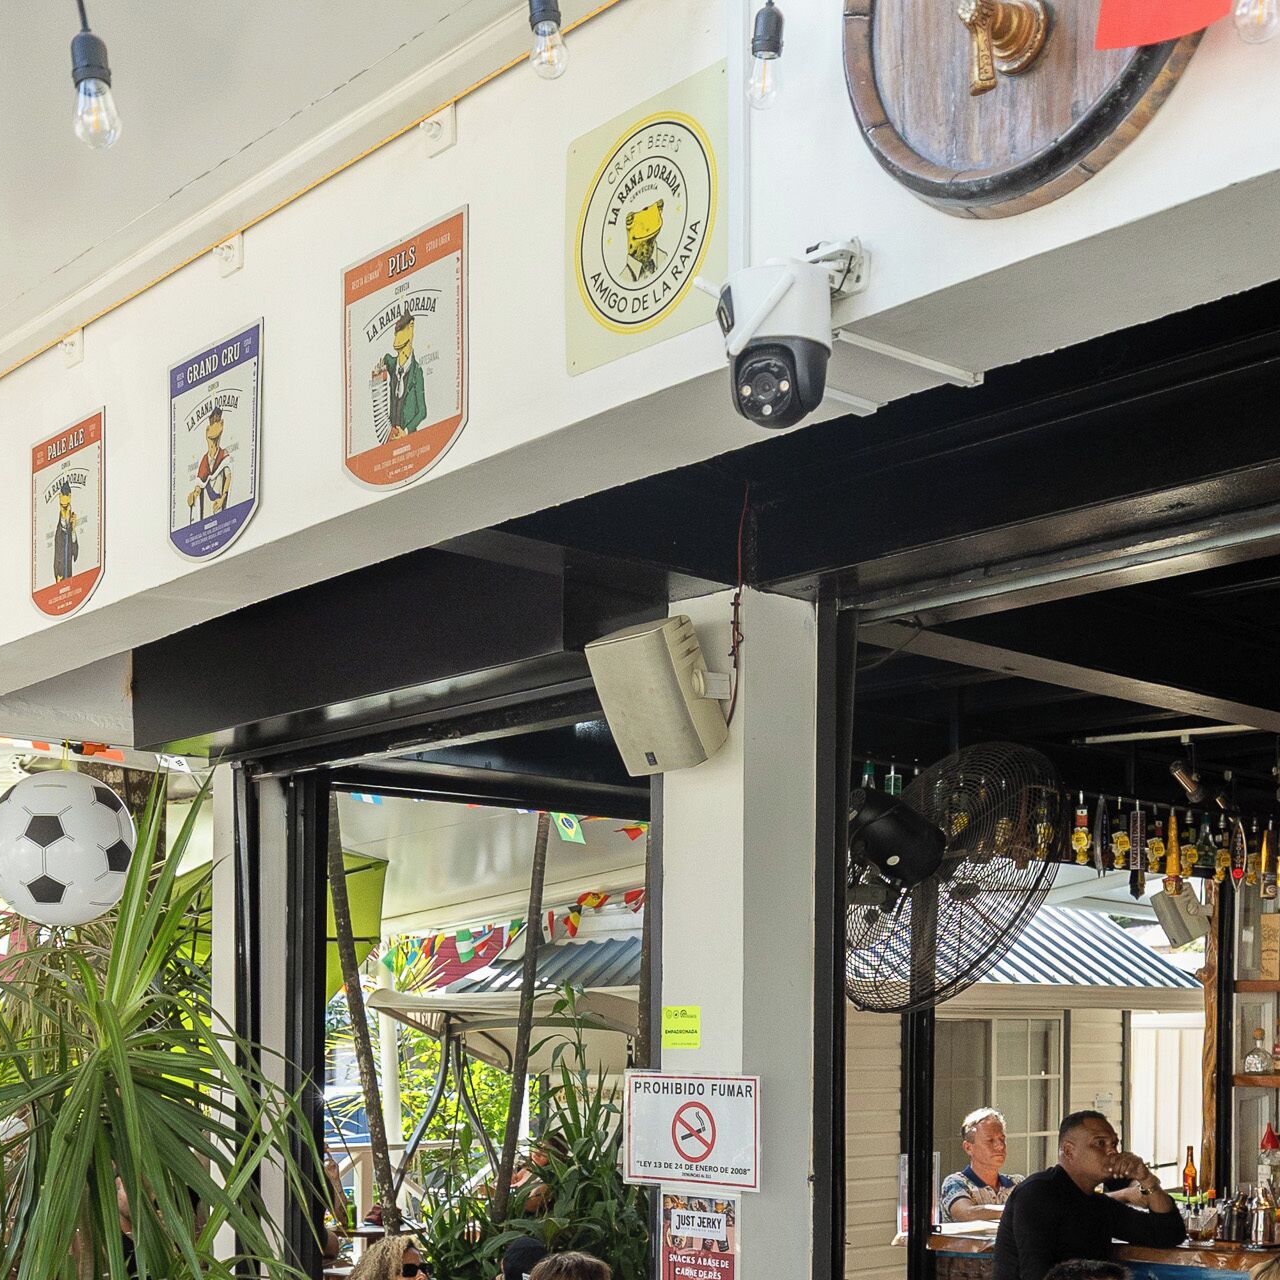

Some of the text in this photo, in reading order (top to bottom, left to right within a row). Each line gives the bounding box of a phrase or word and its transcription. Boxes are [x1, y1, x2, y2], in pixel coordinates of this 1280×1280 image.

[607, 133, 682, 185] CRAFT BEERS
[608, 164, 680, 226] LA RANA DORADA
[388, 245, 417, 277] PILS
[590, 220, 701, 314] AMIGO DE LA RANA
[366, 296, 437, 343] LA RANA DORADA
[186, 341, 241, 384] GRAND CRU
[187, 417, 195, 432] LA
[196, 400, 212, 421] RANA
[47, 437, 67, 461] PALE
[68, 428, 85, 449] ALE
[634, 1081, 754, 1098] PROHIBIDO FUMAR
[653, 1161, 662, 1169] 13
[664, 1162, 673, 1170] DE
[674, 1162, 683, 1170] 24
[685, 1163, 694, 1171] DE
[696, 1164, 719, 1174] ENERO
[720, 1166, 729, 1174] DE
[675, 1214, 722, 1230] JUST JERKY
[669, 1253, 730, 1269] SNACKS A BASE DE
[675, 1267, 722, 1280] CARNE DE RES
